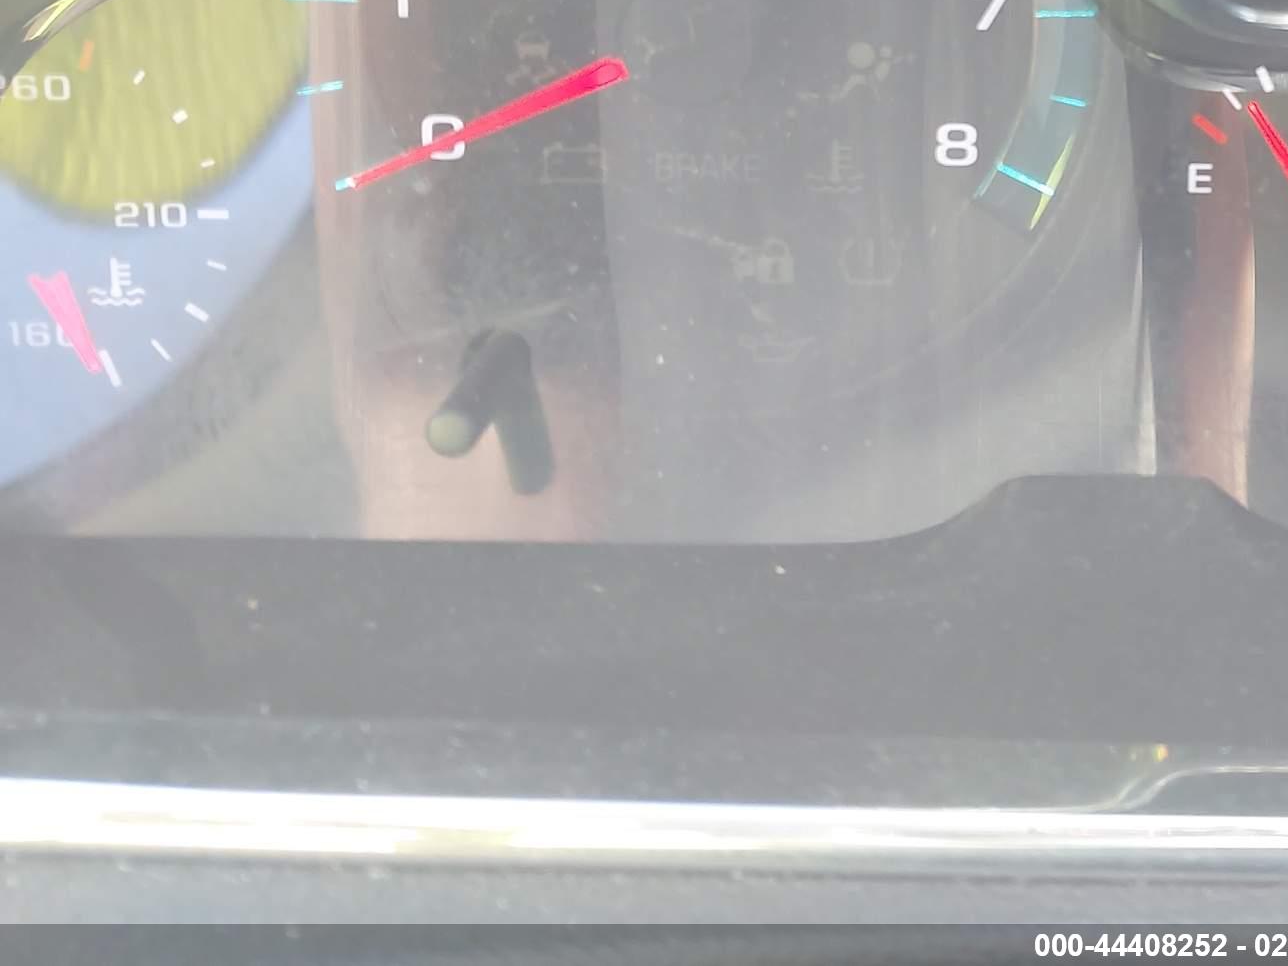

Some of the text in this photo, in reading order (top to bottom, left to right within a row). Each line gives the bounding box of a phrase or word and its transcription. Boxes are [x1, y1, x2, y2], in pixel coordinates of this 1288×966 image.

[0, 74, 72, 102] 60
[420, 114, 466, 161] 0
[934, 122, 978, 168] 8
[654, 151, 762, 184] BRAKE
[1187, 162, 1213, 194] E
[114, 201, 188, 228] 210
